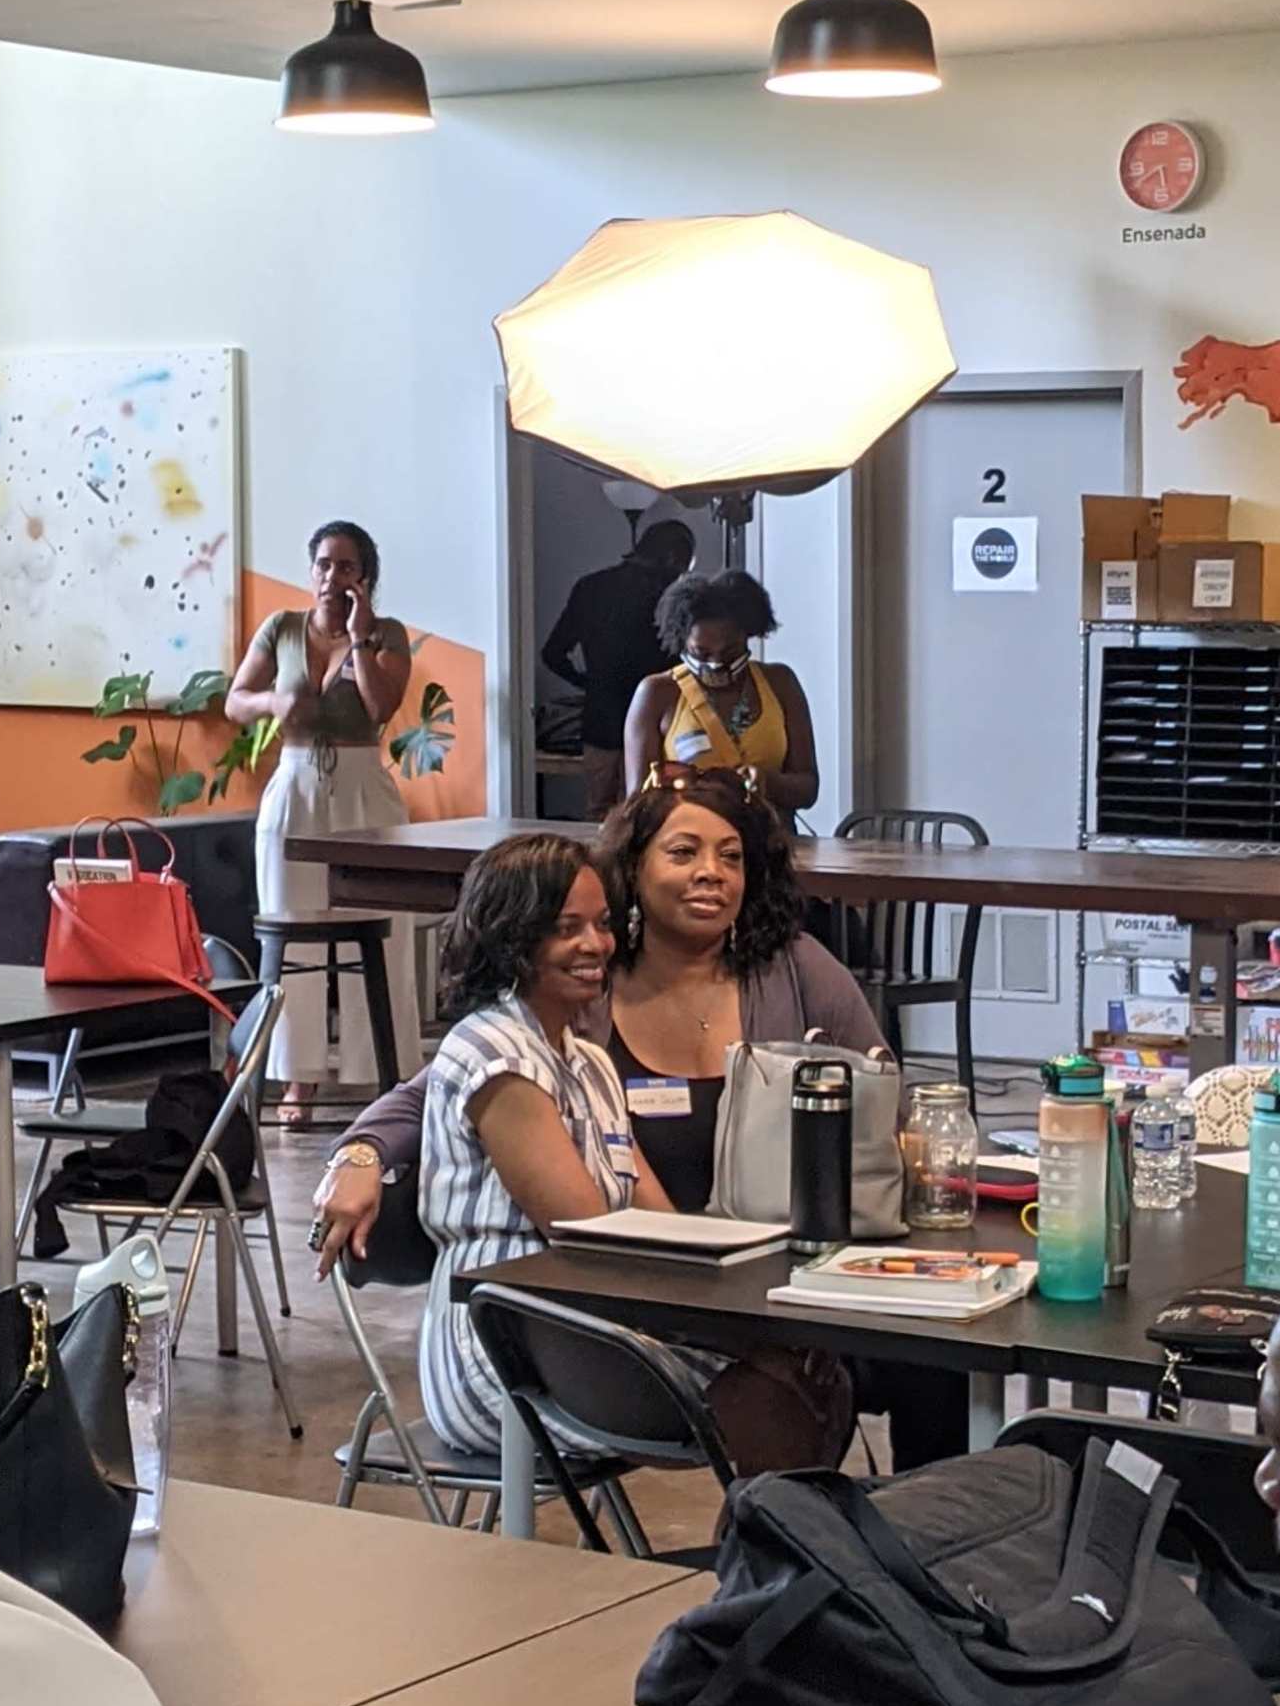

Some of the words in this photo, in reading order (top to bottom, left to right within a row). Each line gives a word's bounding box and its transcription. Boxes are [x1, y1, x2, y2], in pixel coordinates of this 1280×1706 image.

[1152, 131, 1168, 146] 12
[1177, 156, 1193, 172] 3
[1122, 223, 1207, 244] Ensenada
[982, 468, 1007, 503] 2
[975, 545, 1015, 556] REPAIR
[1115, 918, 1162, 932] POSTAL
